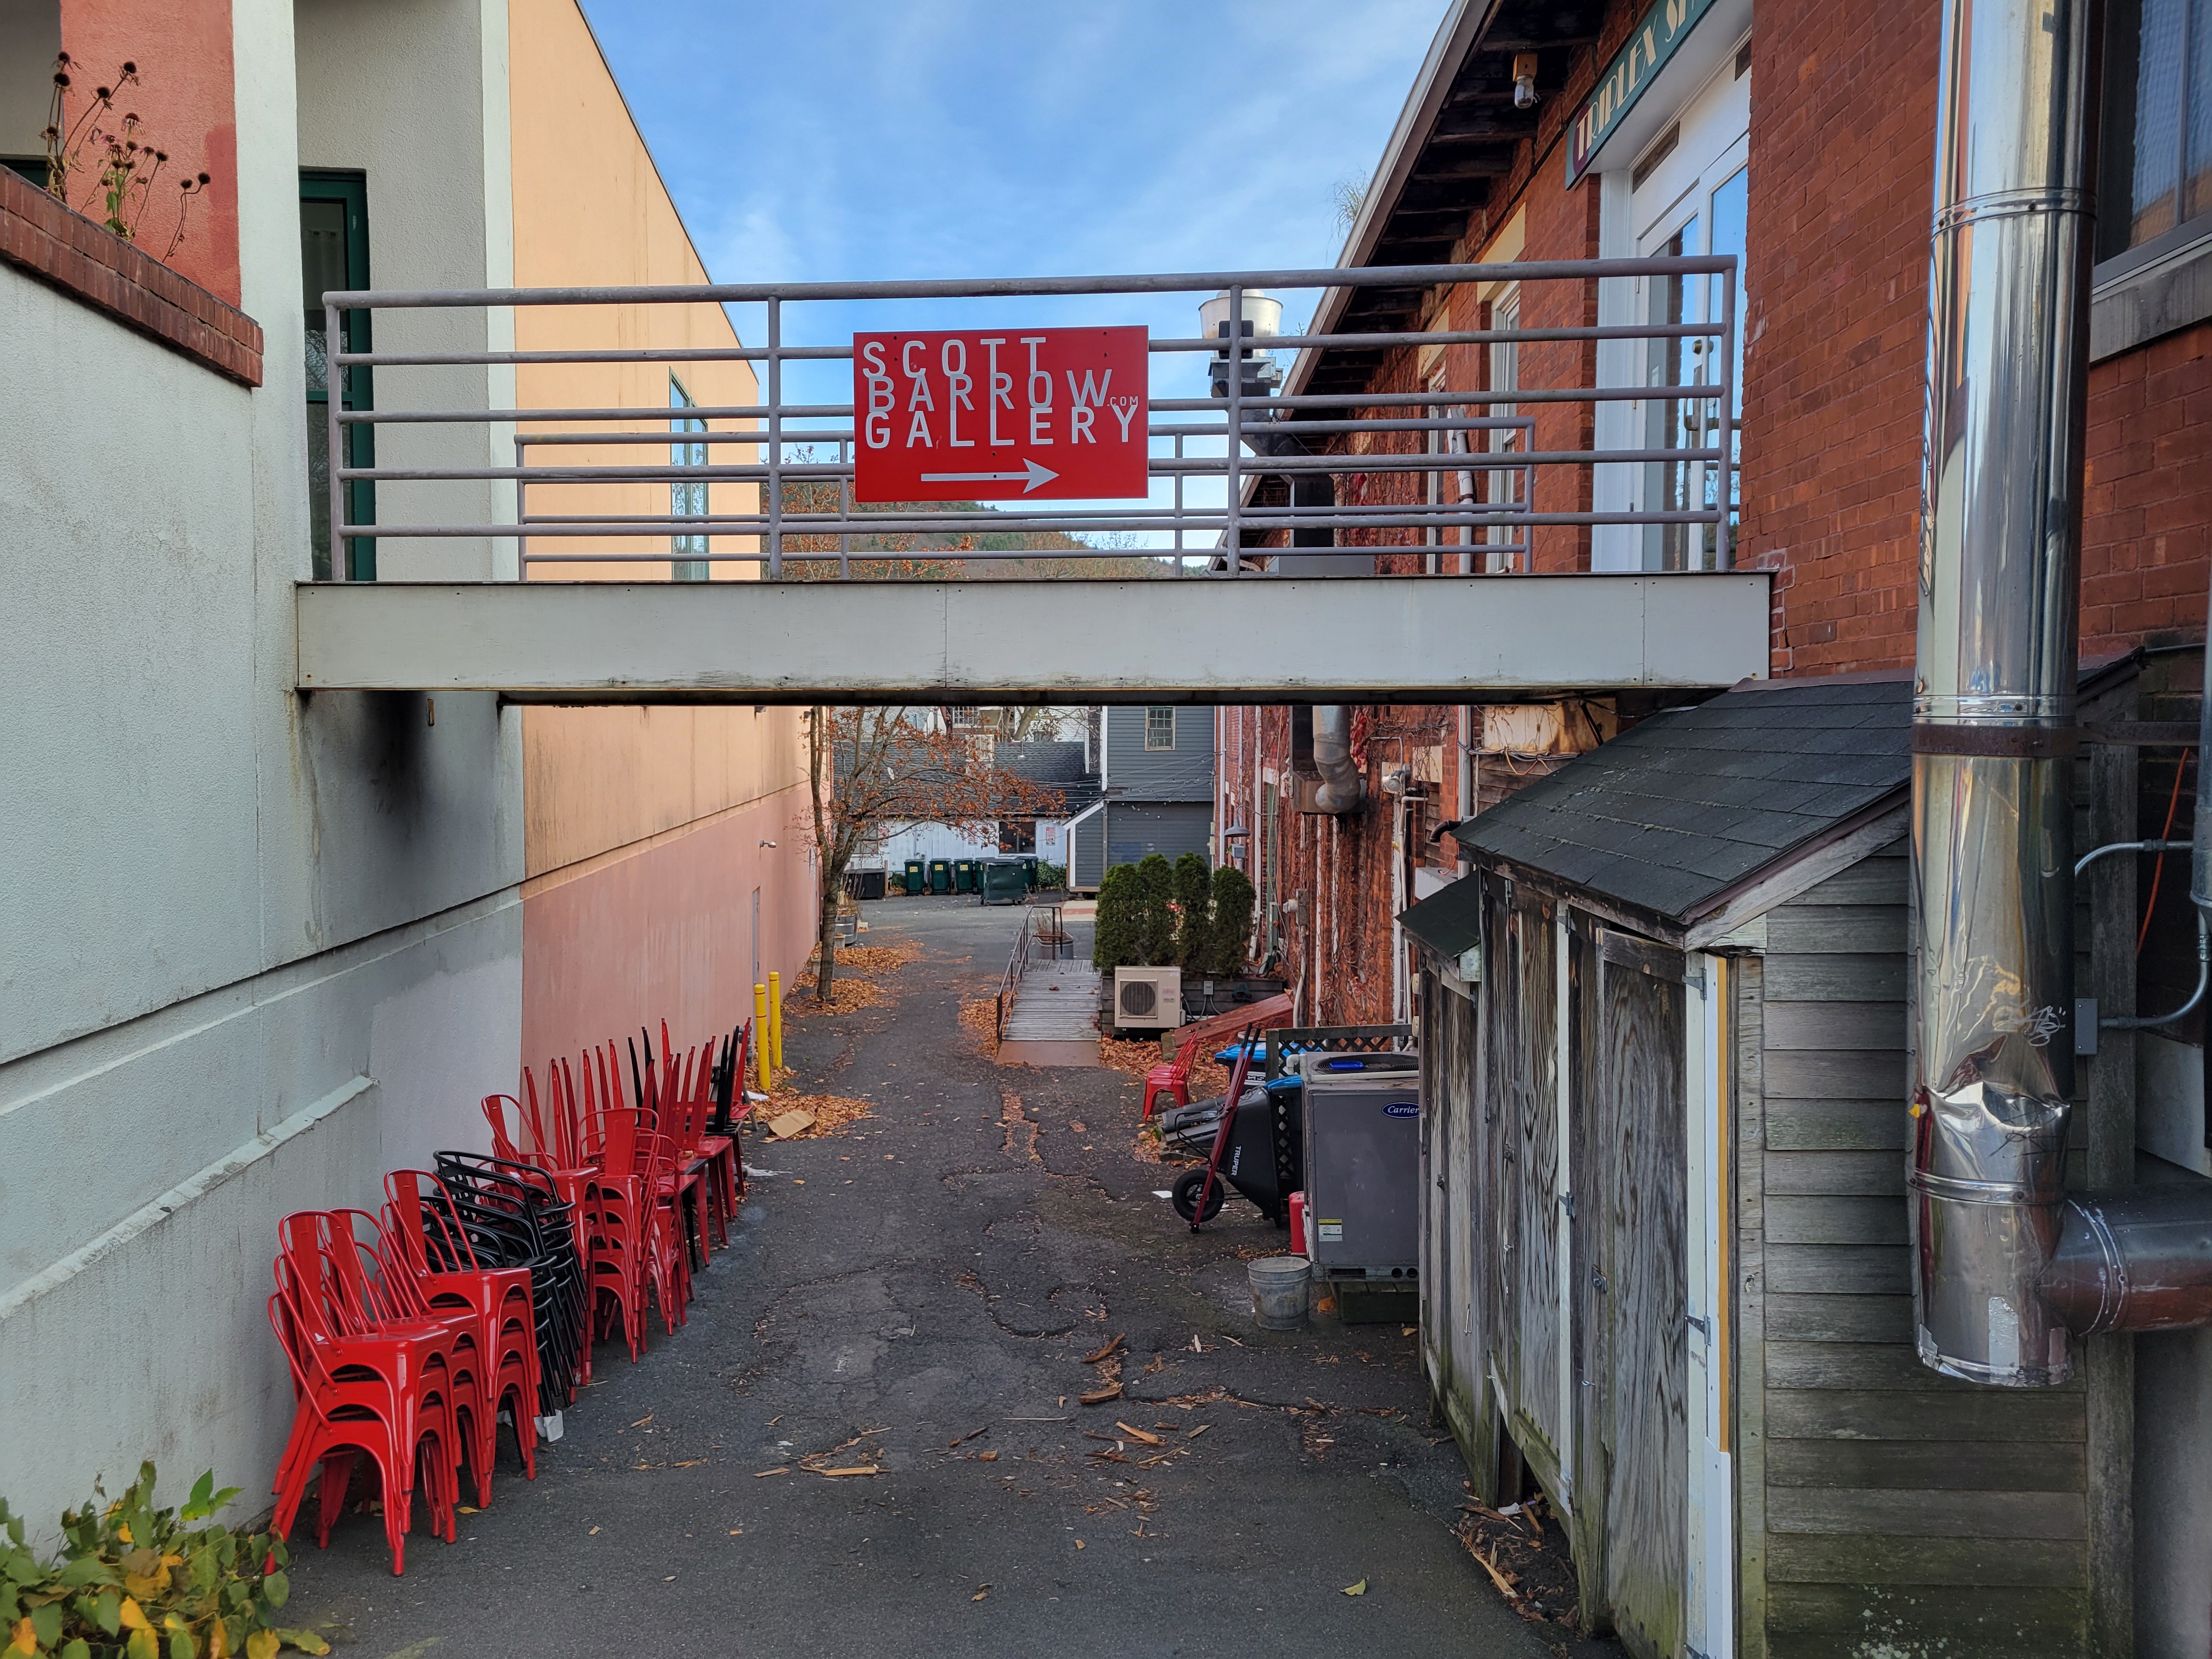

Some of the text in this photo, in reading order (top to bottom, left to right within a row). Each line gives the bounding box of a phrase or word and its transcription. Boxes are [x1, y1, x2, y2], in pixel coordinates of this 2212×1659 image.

[1577, 14, 1657, 161] TRIPLEX
[862, 337, 1046, 378] SCOTT
[865, 404, 1138, 449] GALLERY
[1387, 1105, 1419, 1114] Carrier
[1231, 1146, 1242, 1176] TRUPER
